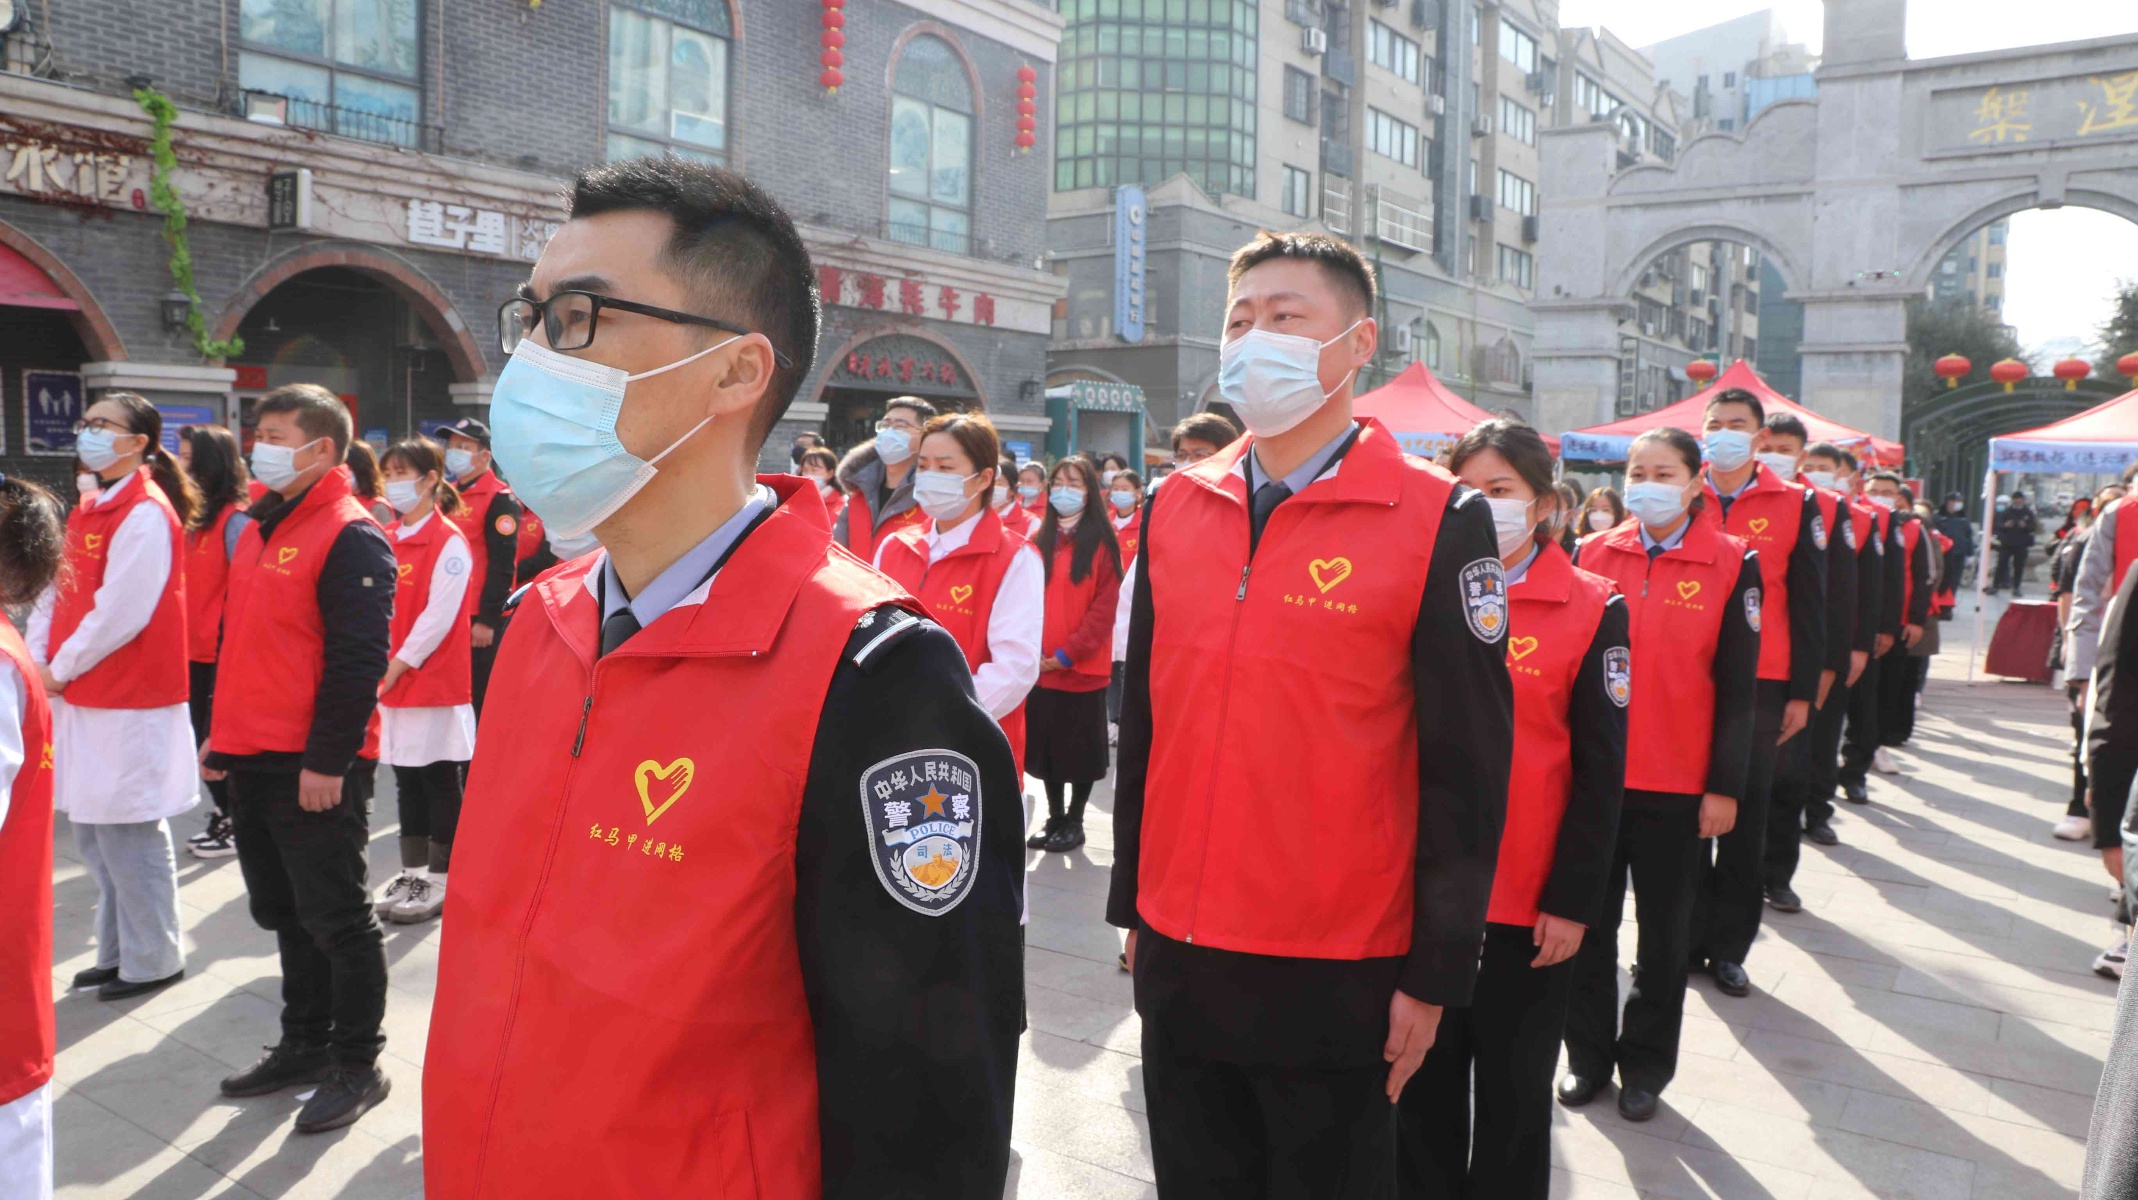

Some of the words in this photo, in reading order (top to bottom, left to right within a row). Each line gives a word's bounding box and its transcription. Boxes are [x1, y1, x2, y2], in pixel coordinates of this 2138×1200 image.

[408, 199, 506, 254] 巷子里
[1283, 593, 1359, 614] 红马甲进网格
[873, 761, 972, 801] 中华人民共和国
[589, 822, 685, 862] 红马甲进网格
[910, 822, 956, 840] POLICE
